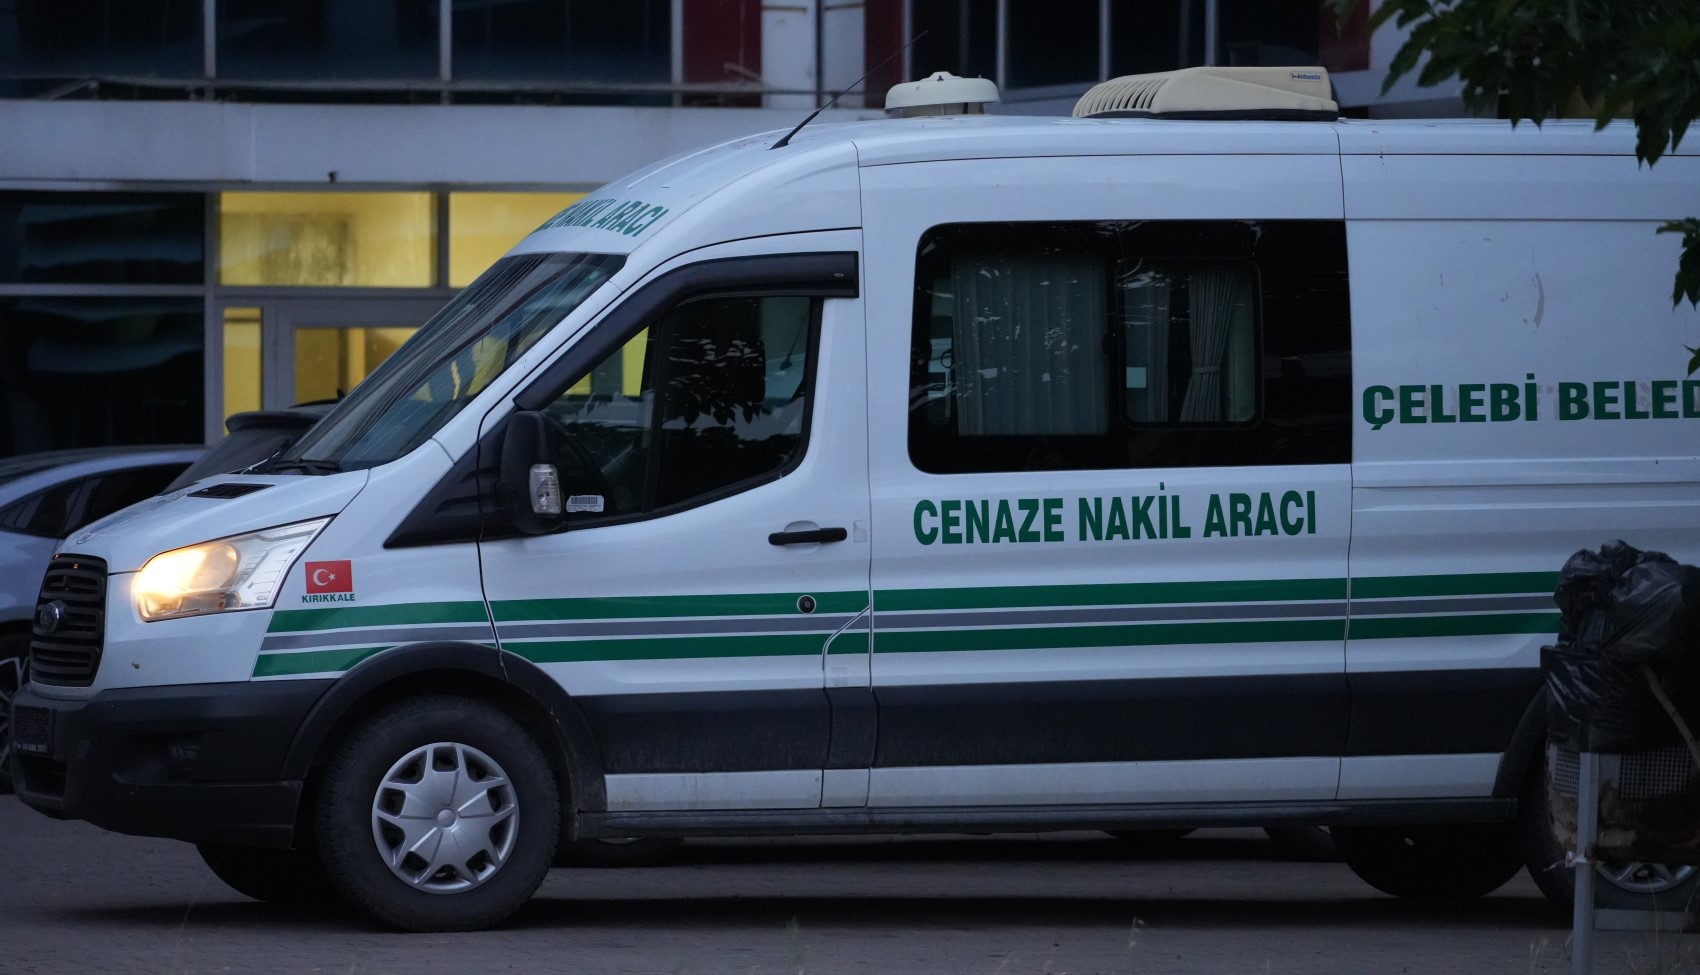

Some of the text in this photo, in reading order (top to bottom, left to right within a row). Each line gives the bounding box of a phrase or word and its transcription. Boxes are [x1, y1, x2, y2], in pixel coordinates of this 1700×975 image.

[590, 200, 670, 237] ARACI
[1362, 373, 1538, 431] ÇELEBİ
[913, 482, 1316, 545] CENAZE NAKİL ARACI
[301, 593, 356, 603] KIRIKKALE
